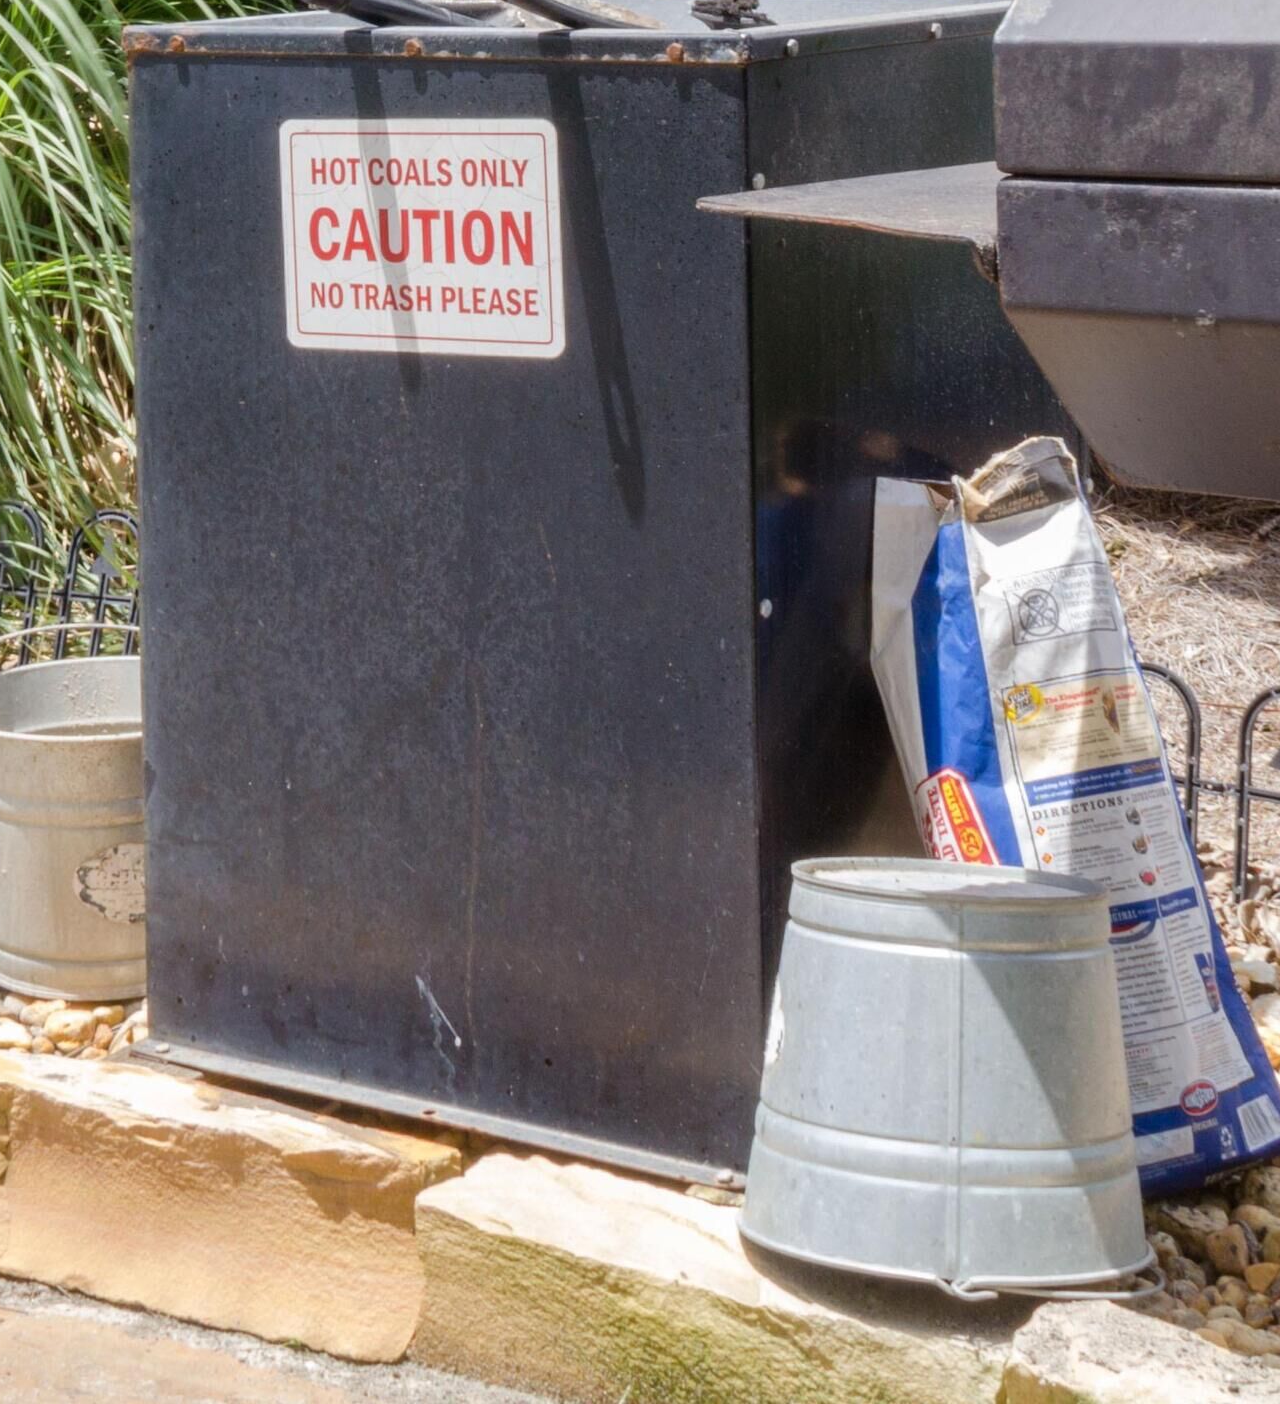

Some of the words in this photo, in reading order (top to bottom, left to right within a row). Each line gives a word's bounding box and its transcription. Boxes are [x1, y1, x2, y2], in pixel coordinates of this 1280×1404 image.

[311, 157, 360, 185] HOT
[368, 158, 452, 186] COALS
[461, 159, 528, 187] ONLY
[309, 207, 534, 266] CAUTION
[310, 282, 343, 309] NO
[350, 284, 432, 312] TRASH
[441, 287, 539, 316] PLEASE
[1032, 796, 1124, 821] DIRECTIONS
